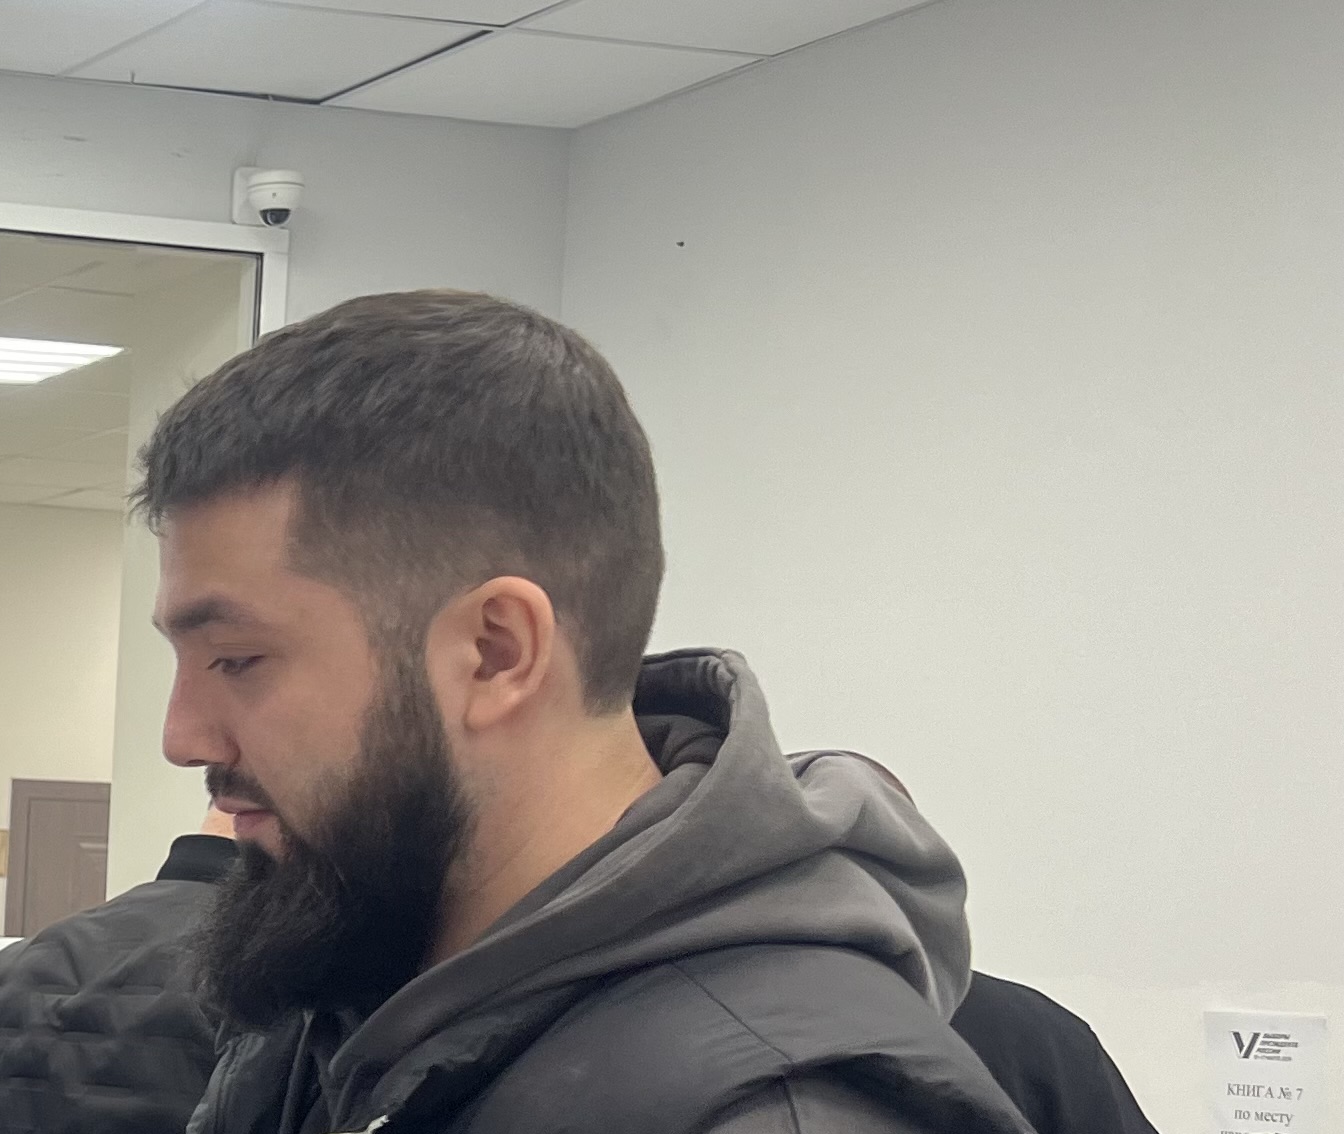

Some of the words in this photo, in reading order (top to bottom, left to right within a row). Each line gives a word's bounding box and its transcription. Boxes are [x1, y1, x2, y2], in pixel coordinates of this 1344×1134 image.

[1227, 1083, 1275, 1099] КНИГА
[1296, 1088, 1304, 1101] 7
[1234, 1109, 1251, 1120] по
[1254, 1111, 1295, 1127] месту
